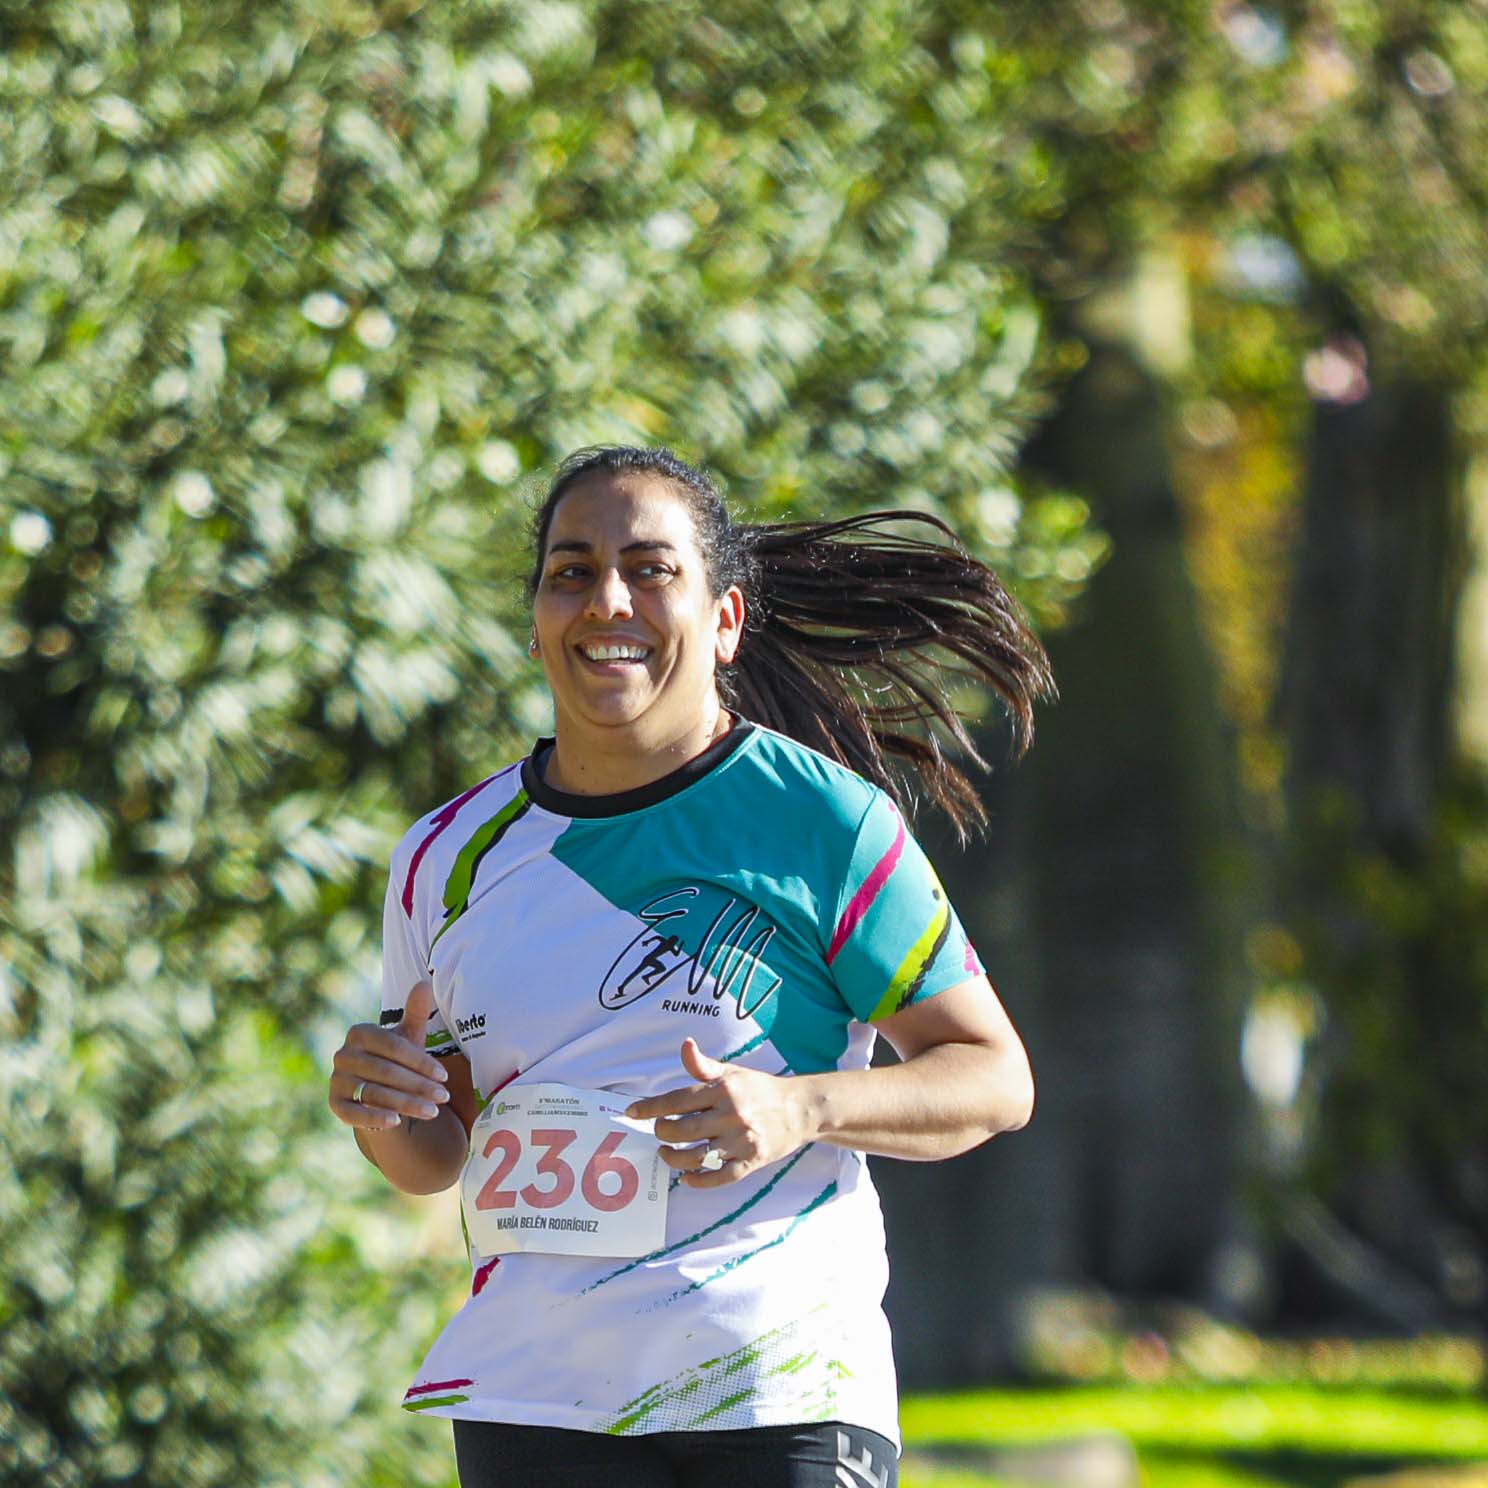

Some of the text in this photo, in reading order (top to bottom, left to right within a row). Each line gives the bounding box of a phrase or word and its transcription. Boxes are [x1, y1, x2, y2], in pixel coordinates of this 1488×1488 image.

[662, 1000, 720, 1017] RUNNING
[475, 1129, 639, 1212] 236
[497, 1214, 599, 1233] MARÍA BELÉN RODRÍGUEZ
